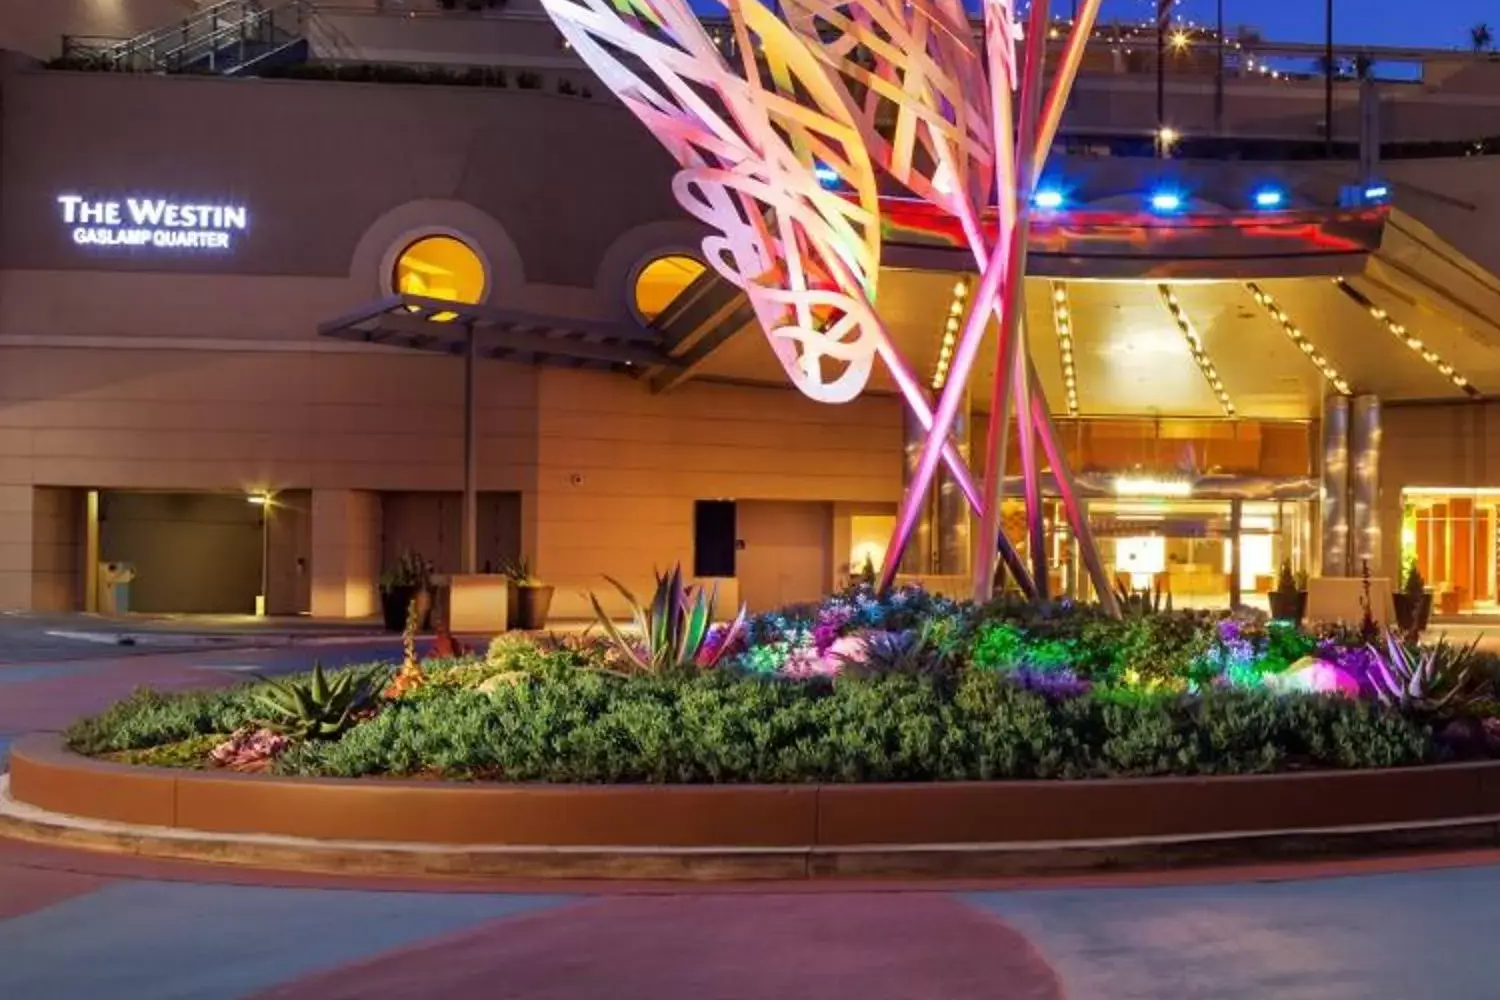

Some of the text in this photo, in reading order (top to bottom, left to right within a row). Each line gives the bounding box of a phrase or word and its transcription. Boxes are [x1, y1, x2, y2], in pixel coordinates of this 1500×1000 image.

[58, 195, 246, 229] THE WESTIN
[73, 228, 229, 249] GASLAMP QUARTER
